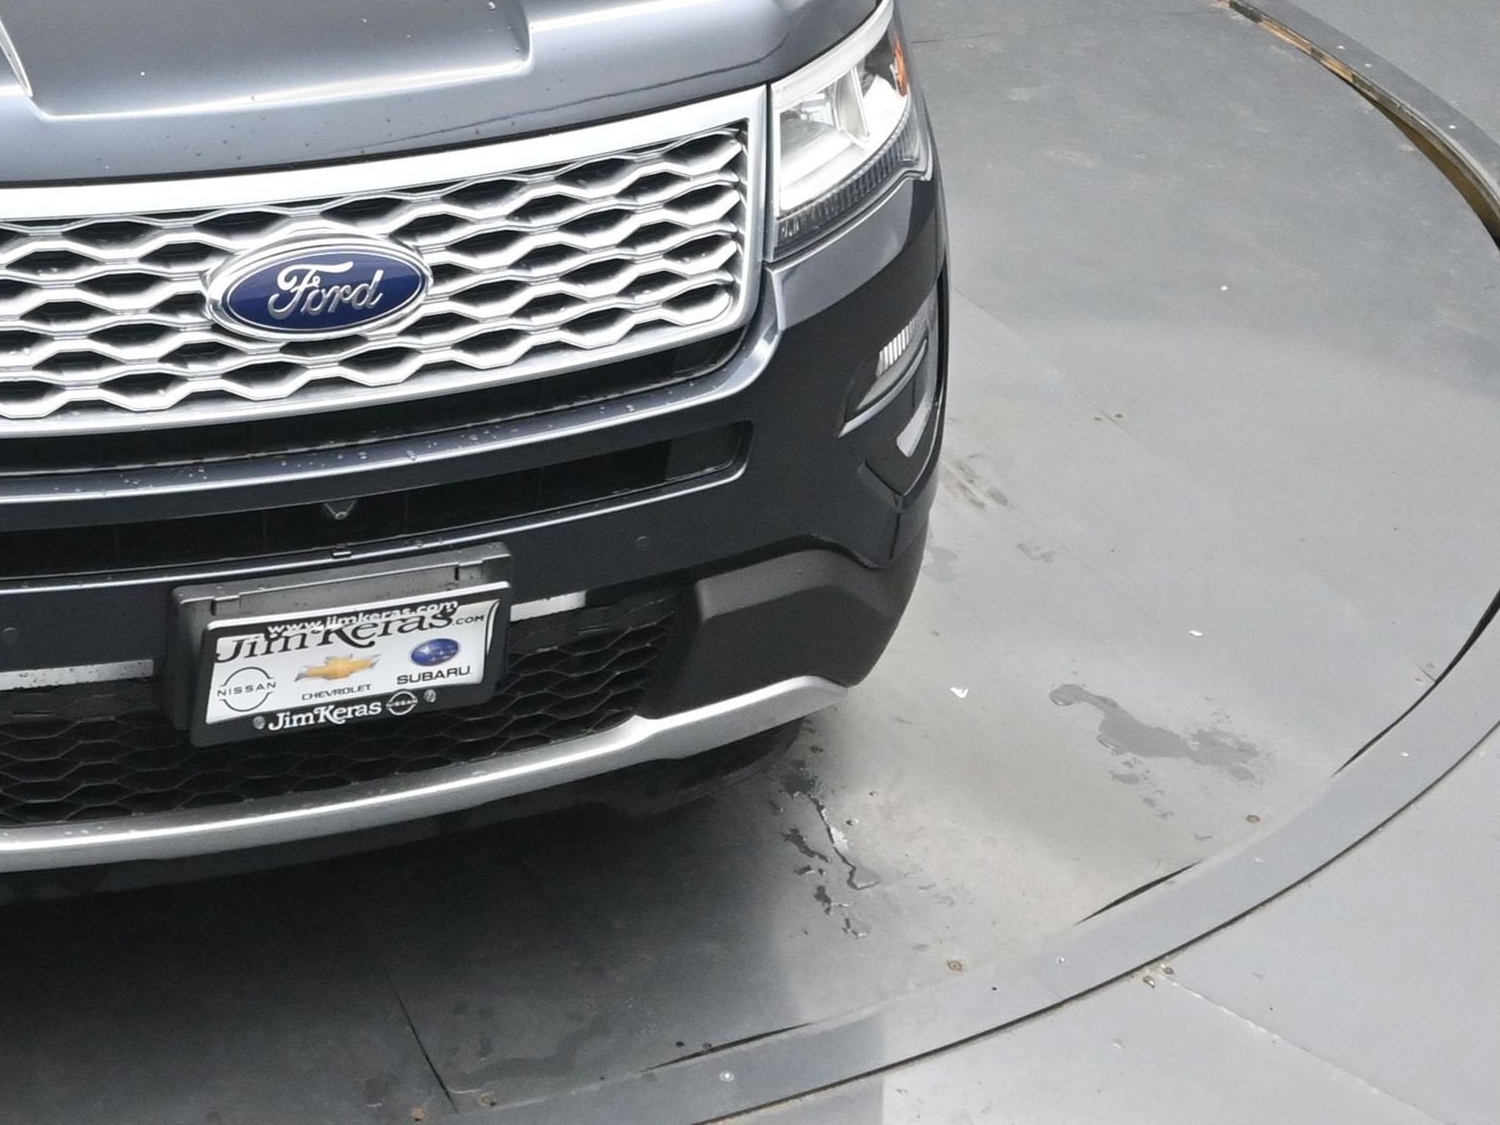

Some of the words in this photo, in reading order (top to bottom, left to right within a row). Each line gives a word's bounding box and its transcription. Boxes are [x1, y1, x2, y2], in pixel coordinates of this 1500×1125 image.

[268, 261, 384, 320] Ford
[397, 665, 471, 685] SUBARU
[217, 681, 277, 697] NISSAN
[301, 683, 372, 701] CHEVROLET
